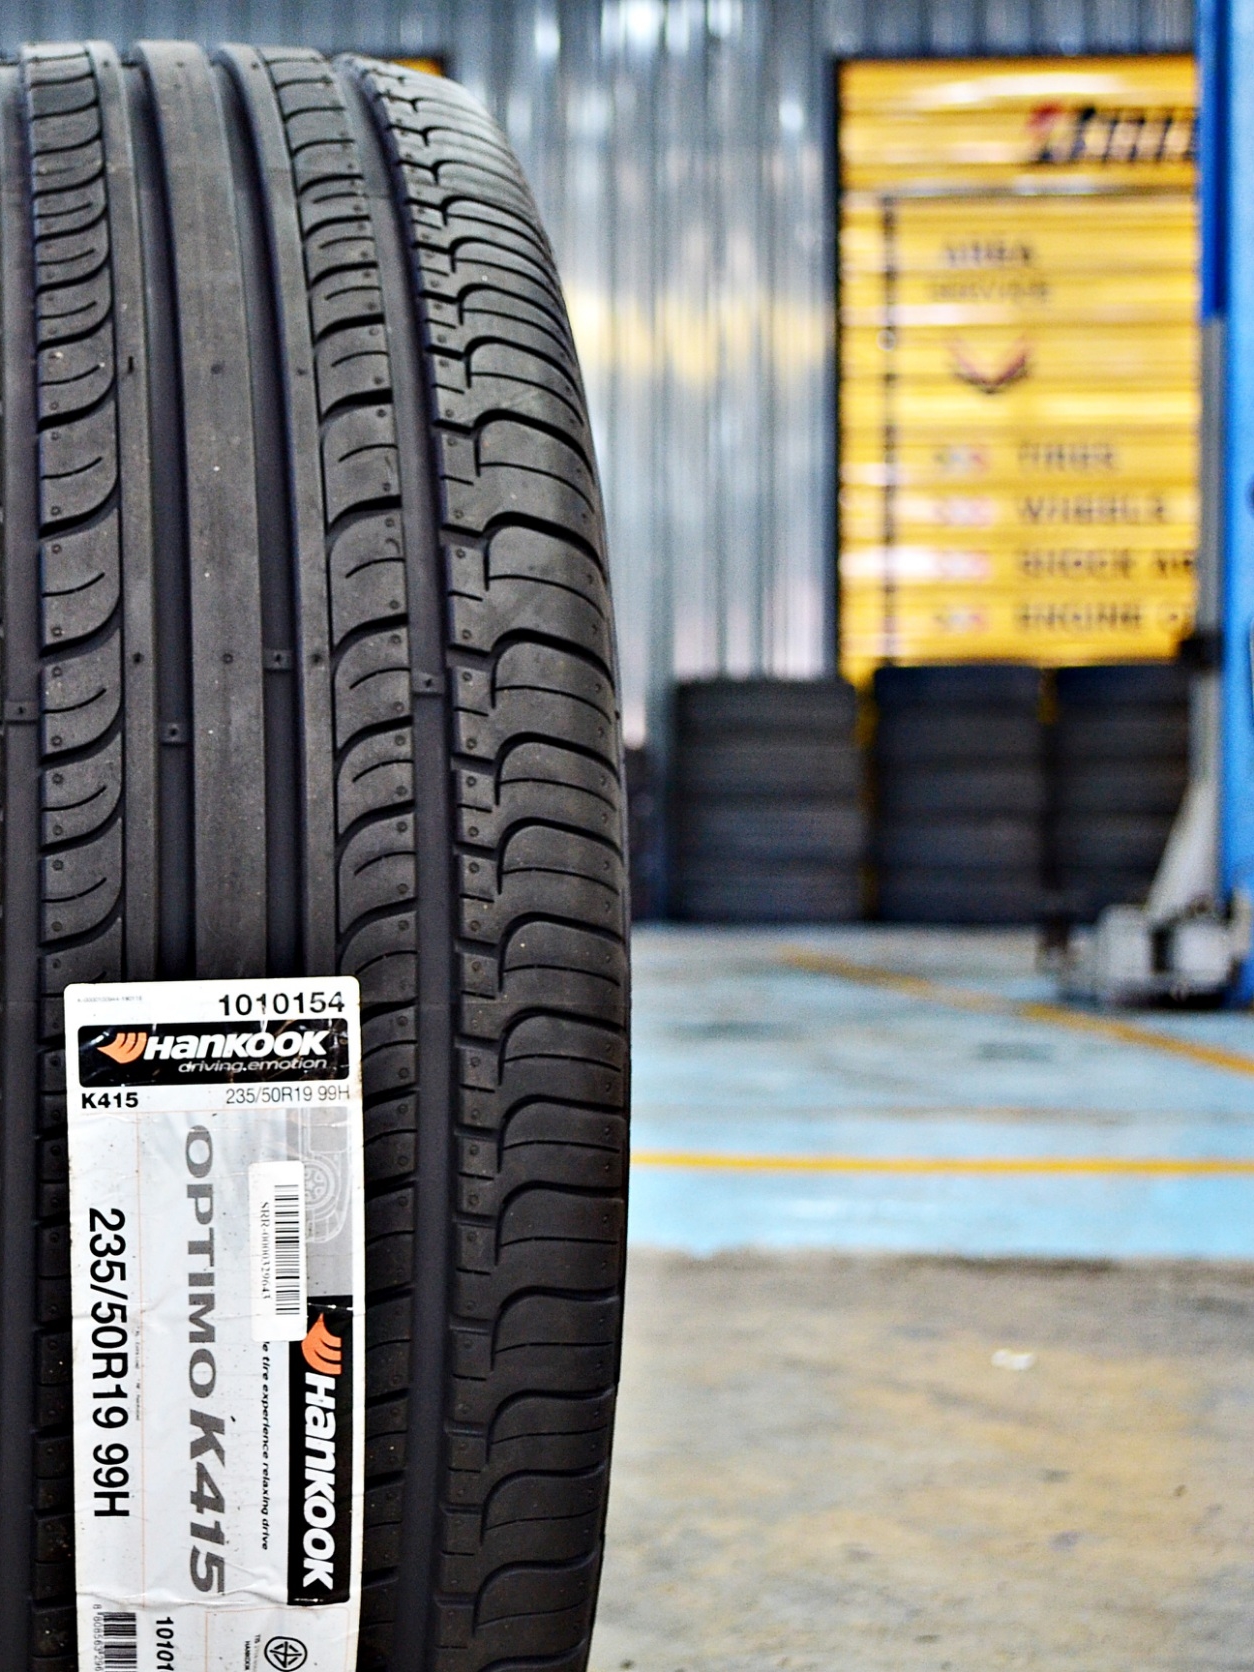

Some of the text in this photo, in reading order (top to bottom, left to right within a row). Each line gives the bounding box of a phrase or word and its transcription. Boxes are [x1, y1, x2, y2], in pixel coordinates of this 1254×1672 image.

[219, 991, 345, 1016] 1010154
[178, 1057, 327, 1073] driving.emotion
[81, 1092, 139, 1109] K415
[226, 1084, 350, 1104] 235/50R19 99H
[89, 1208, 130, 1517] 235/50R19 99H
[186, 1125, 226, 1593] OPTIMO K415
[262, 1356, 271, 1380] tire
[261, 1384, 271, 1459] experience
[261, 1462, 271, 1515] relaxing
[262, 1518, 271, 1550] drive
